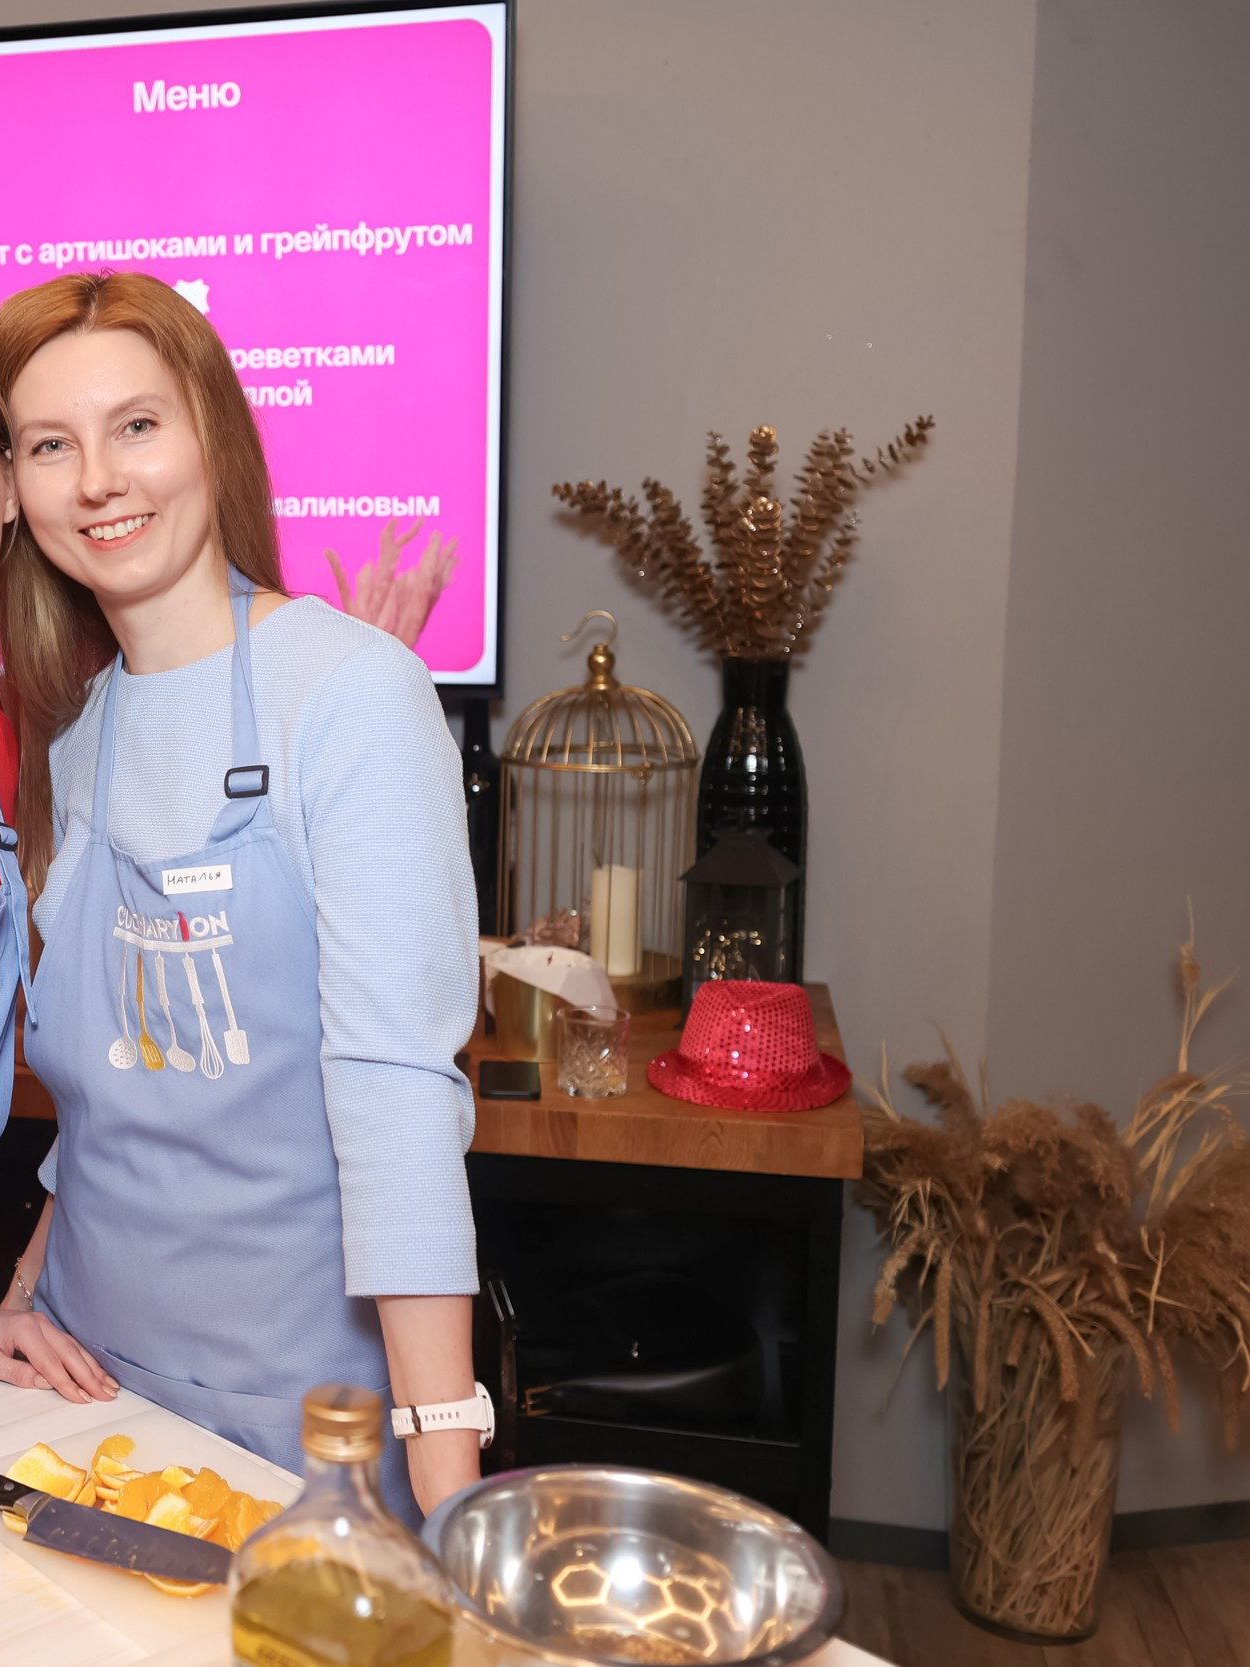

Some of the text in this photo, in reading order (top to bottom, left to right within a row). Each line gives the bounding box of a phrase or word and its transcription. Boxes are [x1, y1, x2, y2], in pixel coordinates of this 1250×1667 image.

[132, 80, 241, 113] Меню
[14, 245, 33, 265] с
[38, 231, 227, 271] артишоками
[233, 235, 252, 256] и
[260, 220, 474, 260] грейпфрутом
[229, 344, 395, 370] реветками
